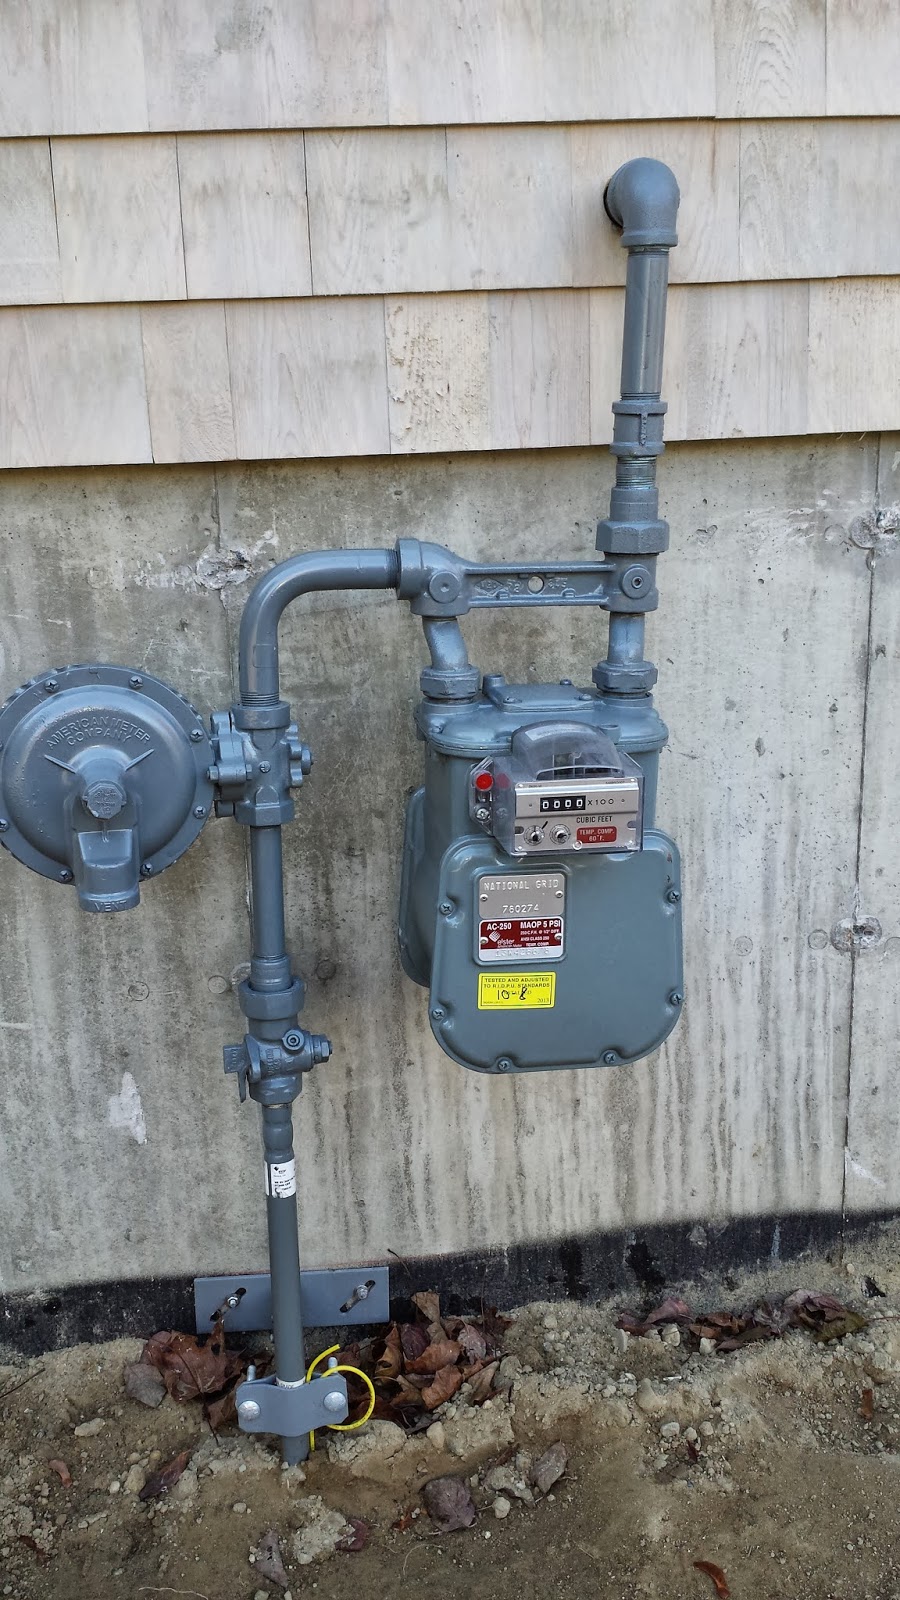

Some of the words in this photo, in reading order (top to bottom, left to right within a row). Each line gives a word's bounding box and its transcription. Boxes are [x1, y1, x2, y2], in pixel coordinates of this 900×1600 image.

[46, 716, 108, 748] AMERICAN
[112, 717, 150, 744] METER
[66, 727, 132, 746] COMPANY
[484, 880, 530, 891] NATIONAL
[535, 880, 559, 889] GRID
[94, 900, 128, 912] VENT
[502, 904, 539, 914] 760274
[487, 922, 512, 930] AC-250
